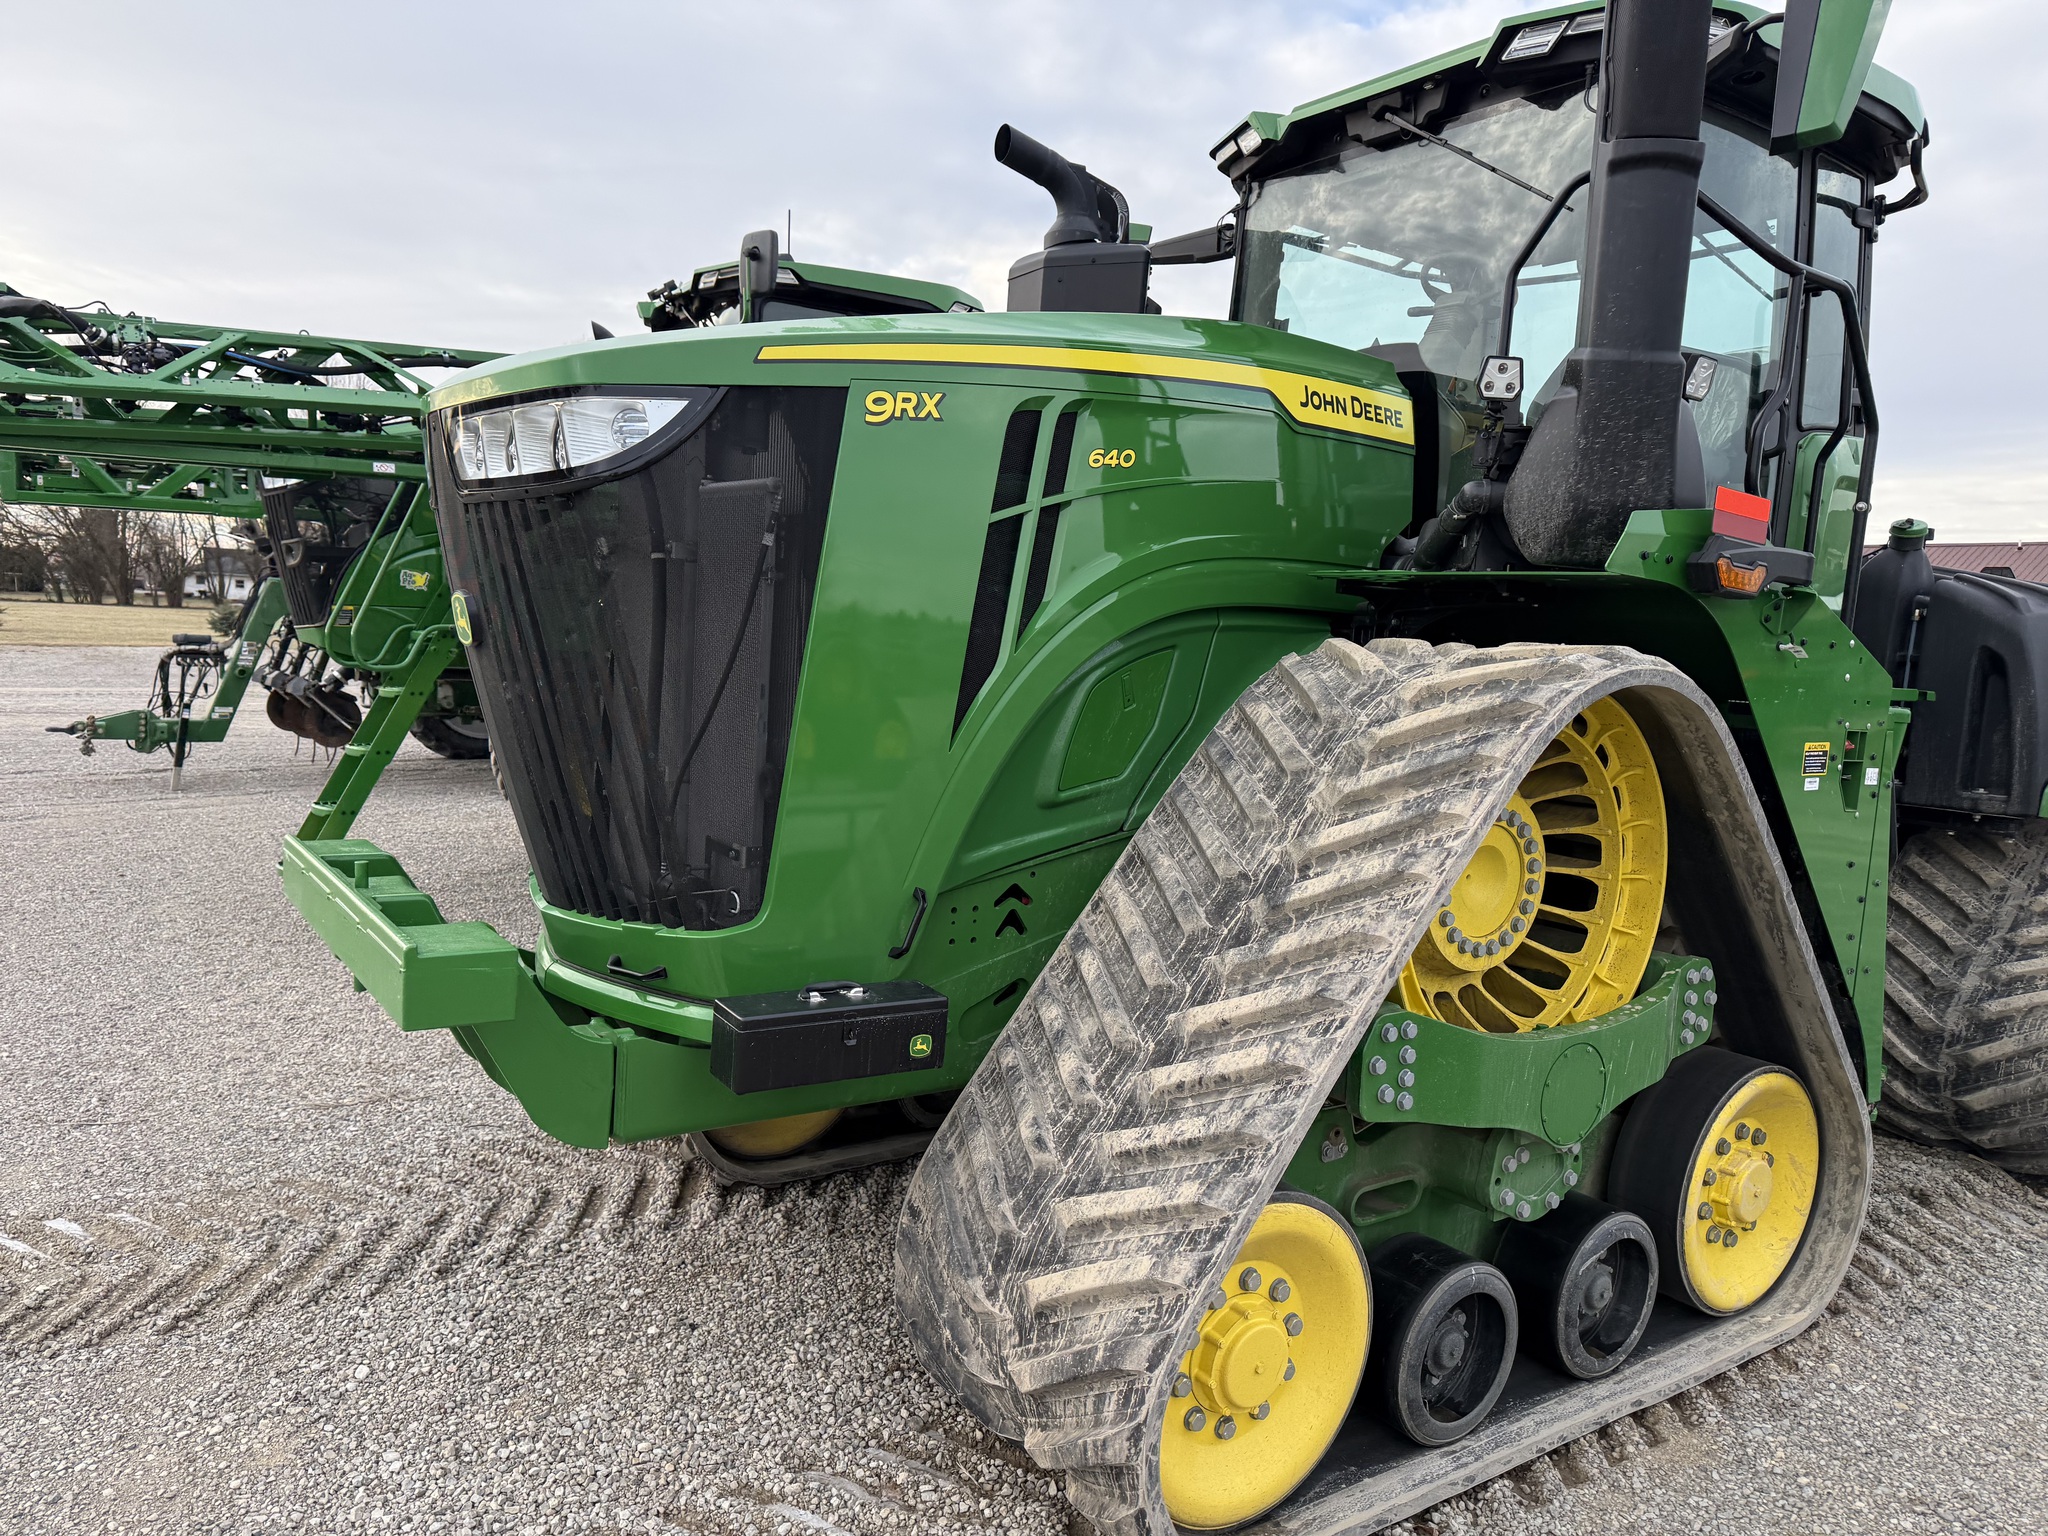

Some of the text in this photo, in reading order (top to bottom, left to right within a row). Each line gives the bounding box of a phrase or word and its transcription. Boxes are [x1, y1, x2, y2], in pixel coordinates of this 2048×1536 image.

[864, 390, 945, 425] 9RX
[1300, 385, 1404, 428] JOHN DEERE
[1088, 448, 1136, 468] 640
